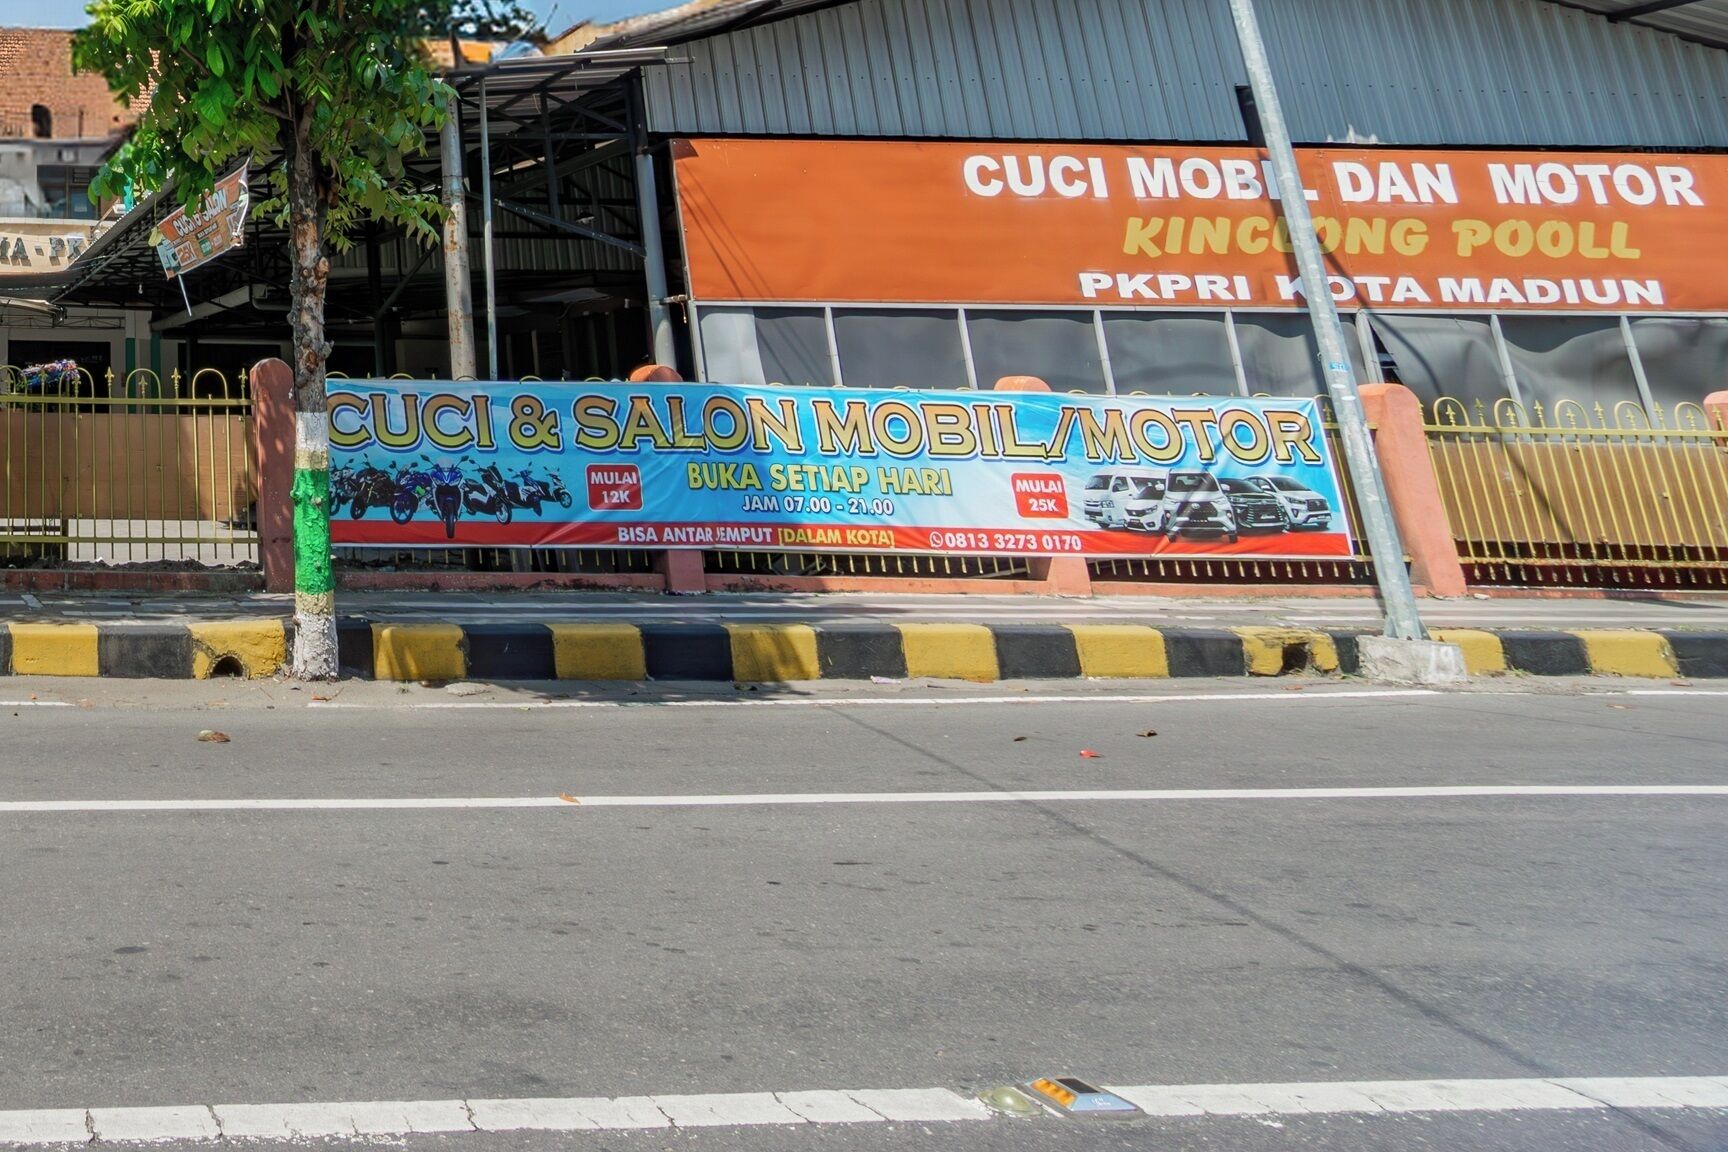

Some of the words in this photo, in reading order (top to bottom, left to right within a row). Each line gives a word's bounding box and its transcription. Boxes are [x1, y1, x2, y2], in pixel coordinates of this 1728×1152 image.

[963, 155, 1108, 198] CUCI
[1127, 157, 1319, 200] MOBI
[1332, 161, 1459, 204] DAN
[1487, 163, 1704, 206] MOTOR
[1451, 219, 1641, 259] POOLL
[1079, 272, 1251, 300] PKPRI
[1275, 275, 1431, 302] KOTA
[1437, 277, 1664, 305] MADIUN
[326, 392, 494, 449] CUCI
[509, 395, 560, 449] &
[573, 395, 803, 452] SALON
[590, 471, 637, 485] MULAI
[687, 462, 763, 491] BUKA
[769, 463, 870, 494] SETIAP
[878, 467, 953, 496] HARI
[1015, 479, 1063, 493] MULAI
[601, 490, 630, 504] 12K
[743, 495, 780, 512] JAM
[784, 496, 831, 514] 07.00
[848, 498, 894, 516] 21.00
[1029, 498, 1059, 512] 25K
[618, 527, 656, 542] BISA
[663, 528, 713, 542] ANTAR
[716, 528, 772, 543] JEMPUT
[945, 535, 989, 549] 0813
[997, 536, 1038, 550] 3273
[1042, 536, 1082, 551] 0170
